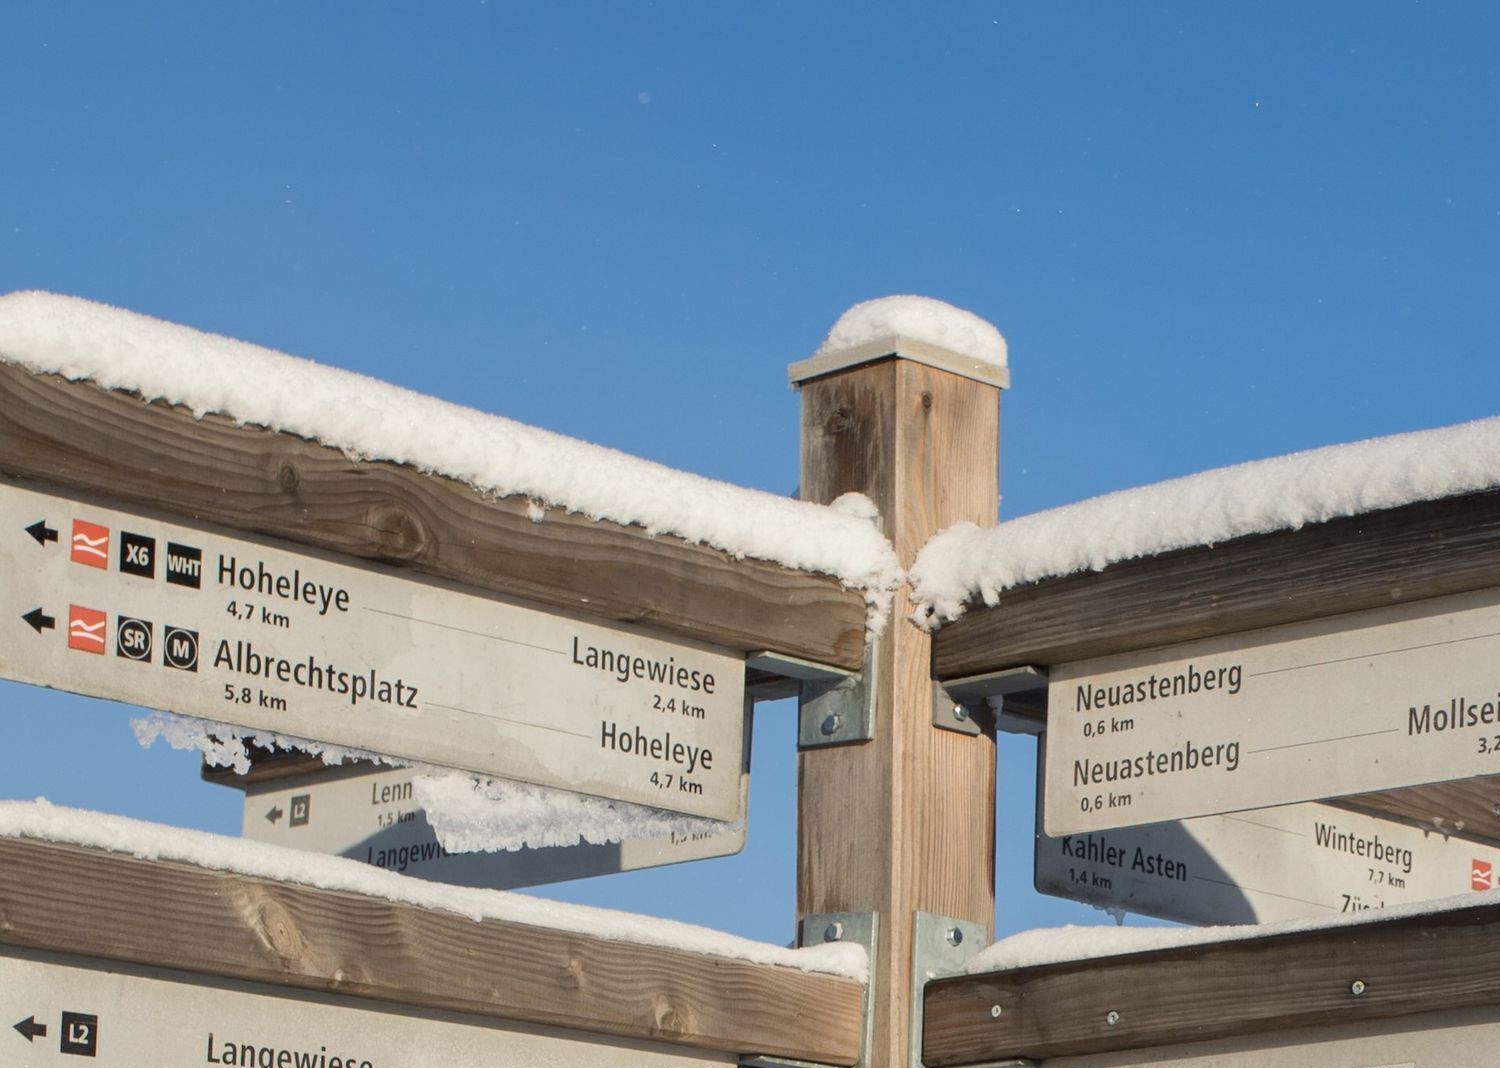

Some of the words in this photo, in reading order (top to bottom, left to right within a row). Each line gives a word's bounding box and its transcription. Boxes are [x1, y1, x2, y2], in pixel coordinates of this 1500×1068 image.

[126, 546, 149, 567] X6
[168, 554, 201, 577] WHT
[218, 554, 350, 615] Hoheleye
[227, 600, 253, 621] 4,7
[262, 606, 290, 628] km
[124, 629, 145, 648] SR
[173, 640, 189, 658] M
[214, 639, 418, 709] Albrechtsplatz
[573, 636, 716, 694] Langewiese
[224, 684, 251, 704] 5,8
[259, 690, 287, 711] km
[1077, 664, 1242, 712] Neuastenberg
[653, 695, 676, 714] 2,4
[682, 700, 705, 719] km
[1084, 720, 1105, 737] 0,6
[1111, 718, 1134, 733] km
[601, 721, 713, 774] Hoheleye
[1074, 741, 1240, 786] Neuastenberg
[650, 772, 673, 792] 4,7
[679, 775, 702, 795] km
[1081, 795, 1102, 813] 0,6
[1109, 793, 1131, 808] km
[377, 812, 393, 828] 1,5
[397, 811, 415, 824] km
[1062, 835, 1126, 867] Kahler
[1131, 847, 1187, 881] Asten
[1314, 822, 1412, 873] Winterberg
[1068, 868, 1087, 885] 1,4
[1092, 871, 1112, 890] km
[1367, 868, 1384, 885] 7,7
[1388, 872, 1405, 889] km
[69, 1024, 89, 1045] L2
